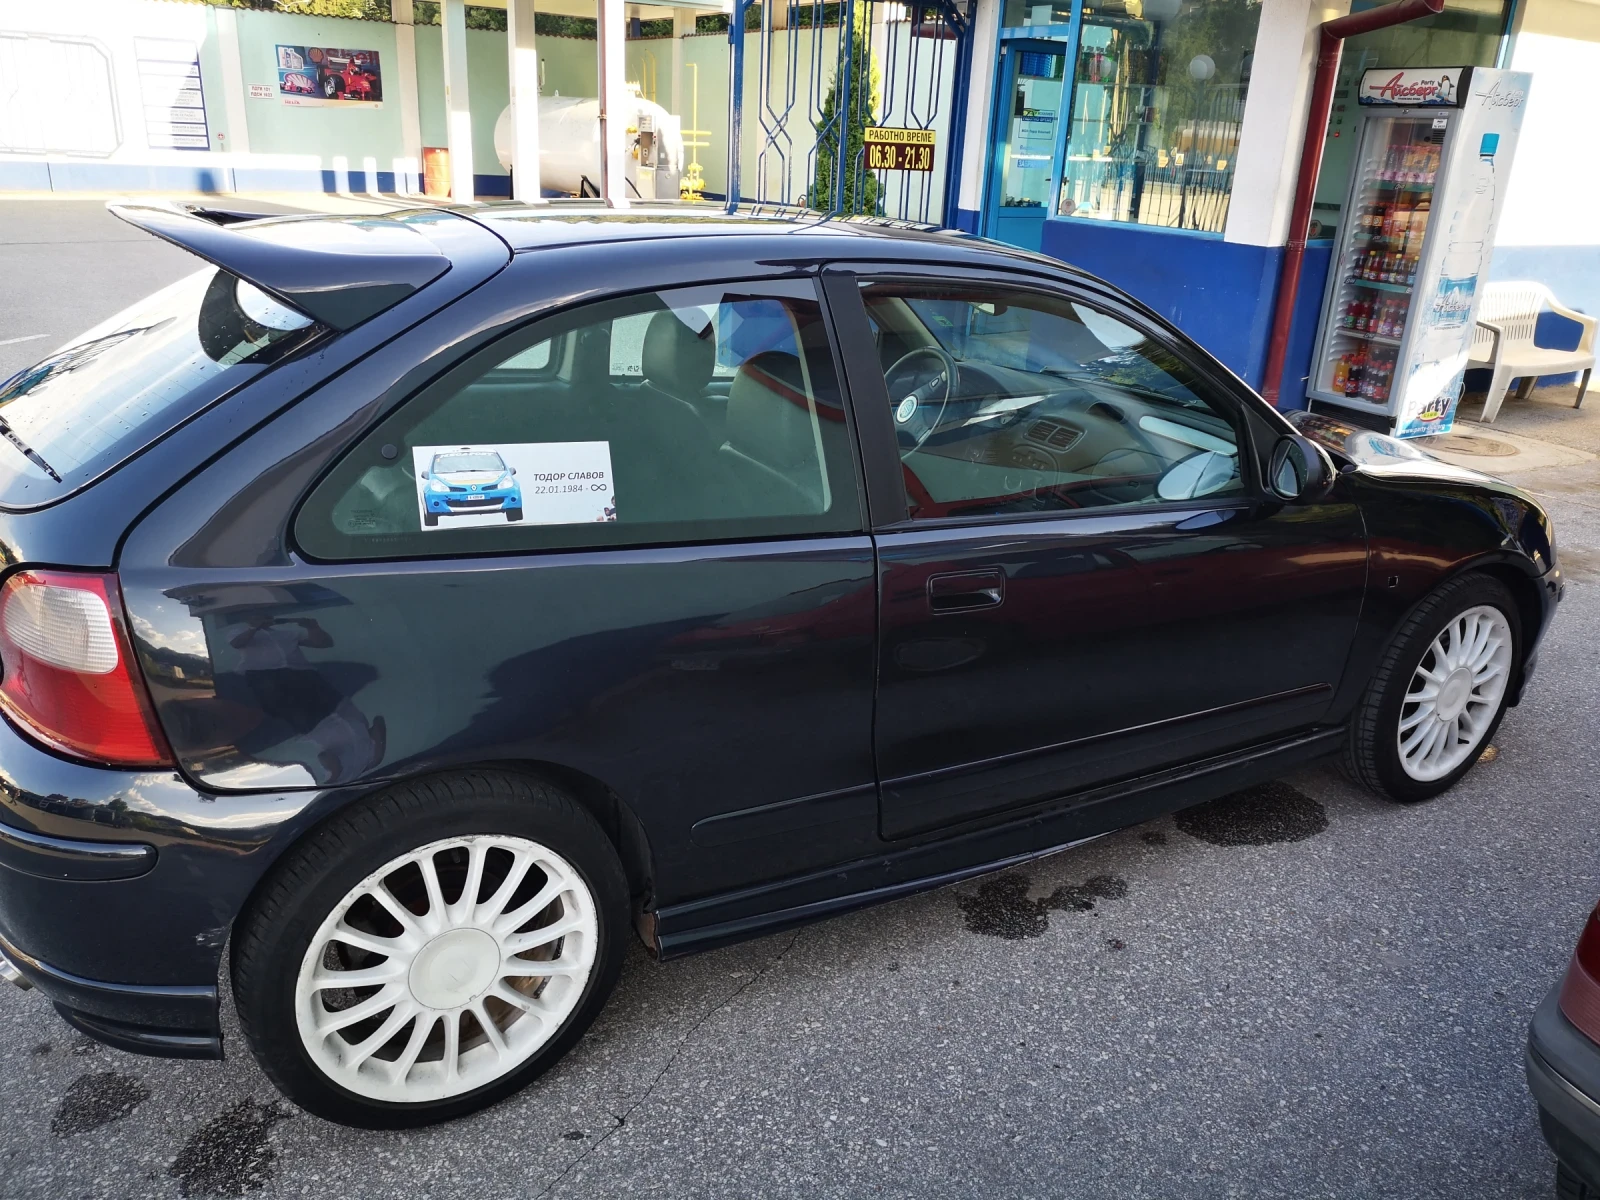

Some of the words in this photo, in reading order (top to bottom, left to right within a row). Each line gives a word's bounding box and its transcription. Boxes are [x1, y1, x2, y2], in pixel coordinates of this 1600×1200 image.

[1369, 72, 1438, 100] Айсберг
[869, 129, 904, 141] РАБОТНО
[906, 131, 932, 142] ВРЕМЕ
[870, 144, 896, 168] 06.30
[904, 146, 930, 169] 21.30
[534, 472, 566, 482] ТОДОР
[567, 471, 604, 481] СЛАВОВ
[534, 484, 583, 494] 22.01.1984
